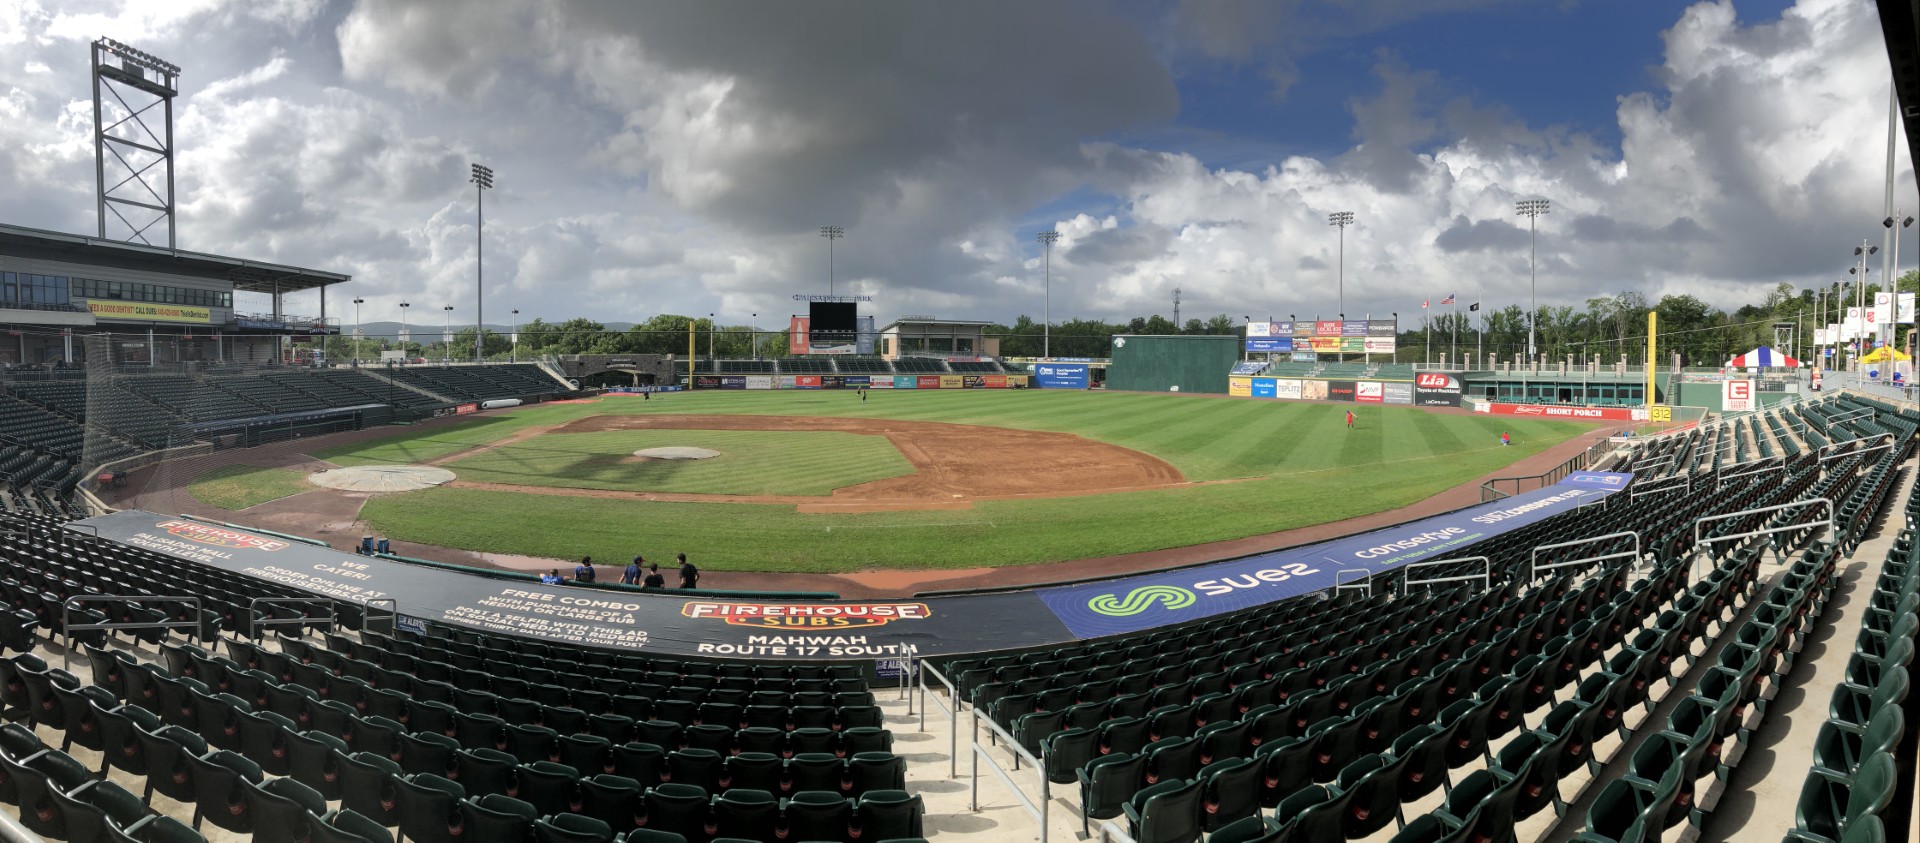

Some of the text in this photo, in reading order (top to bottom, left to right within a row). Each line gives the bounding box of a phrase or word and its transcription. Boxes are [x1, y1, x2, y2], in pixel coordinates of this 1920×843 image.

[135, 306, 145, 314] CALL
[1420, 374, 1445, 386] Lia
[1546, 408, 1573, 416] SHORT
[1574, 409, 1602, 417] PORCH
[1652, 406, 1671, 419] 312
[134, 533, 233, 560] PALISADES MALL
[157, 521, 284, 551] FIREHOUSE
[187, 532, 226, 545] SUBS
[1354, 525, 1466, 559] conserve
[127, 537, 214, 562] FOURTH LEVEL
[313, 564, 372, 581] CATER!
[341, 561, 370, 570] WE
[243, 567, 390, 607] FIREHOUSESUBS.COM
[263, 565, 387, 598] ORDER ONLINE AT
[1193, 562, 1321, 597] suez
[488, 595, 526, 608] WITH
[526, 601, 593, 616] PURCHASE
[600, 611, 622, 619] OF
[500, 588, 640, 611] FREE COMBO
[455, 605, 487, 617] POST
[505, 614, 550, 625] SELFIE
[552, 620, 591, 631] WITH
[593, 626, 623, 635] THIS
[627, 630, 648, 638] AD
[477, 599, 636, 625] MEDIUM OR LARGE SUB
[690, 604, 925, 620] FIREHOUSE
[763, 616, 851, 627] SUBS
[442, 614, 482, 626] EXPIRES
[483, 622, 518, 632] THIRTY
[519, 628, 548, 637] DAYS
[549, 632, 583, 642] AFTER
[585, 637, 614, 645] YOUR
[463, 612, 517, 626] SOCIAL
[518, 621, 562, 633] MEDIA
[566, 629, 586, 637] TO
[588, 631, 651, 643] REDEEM.
[697, 643, 918, 656] ROUTE 17 SOUTH
[748, 635, 867, 646] MAHWAH
